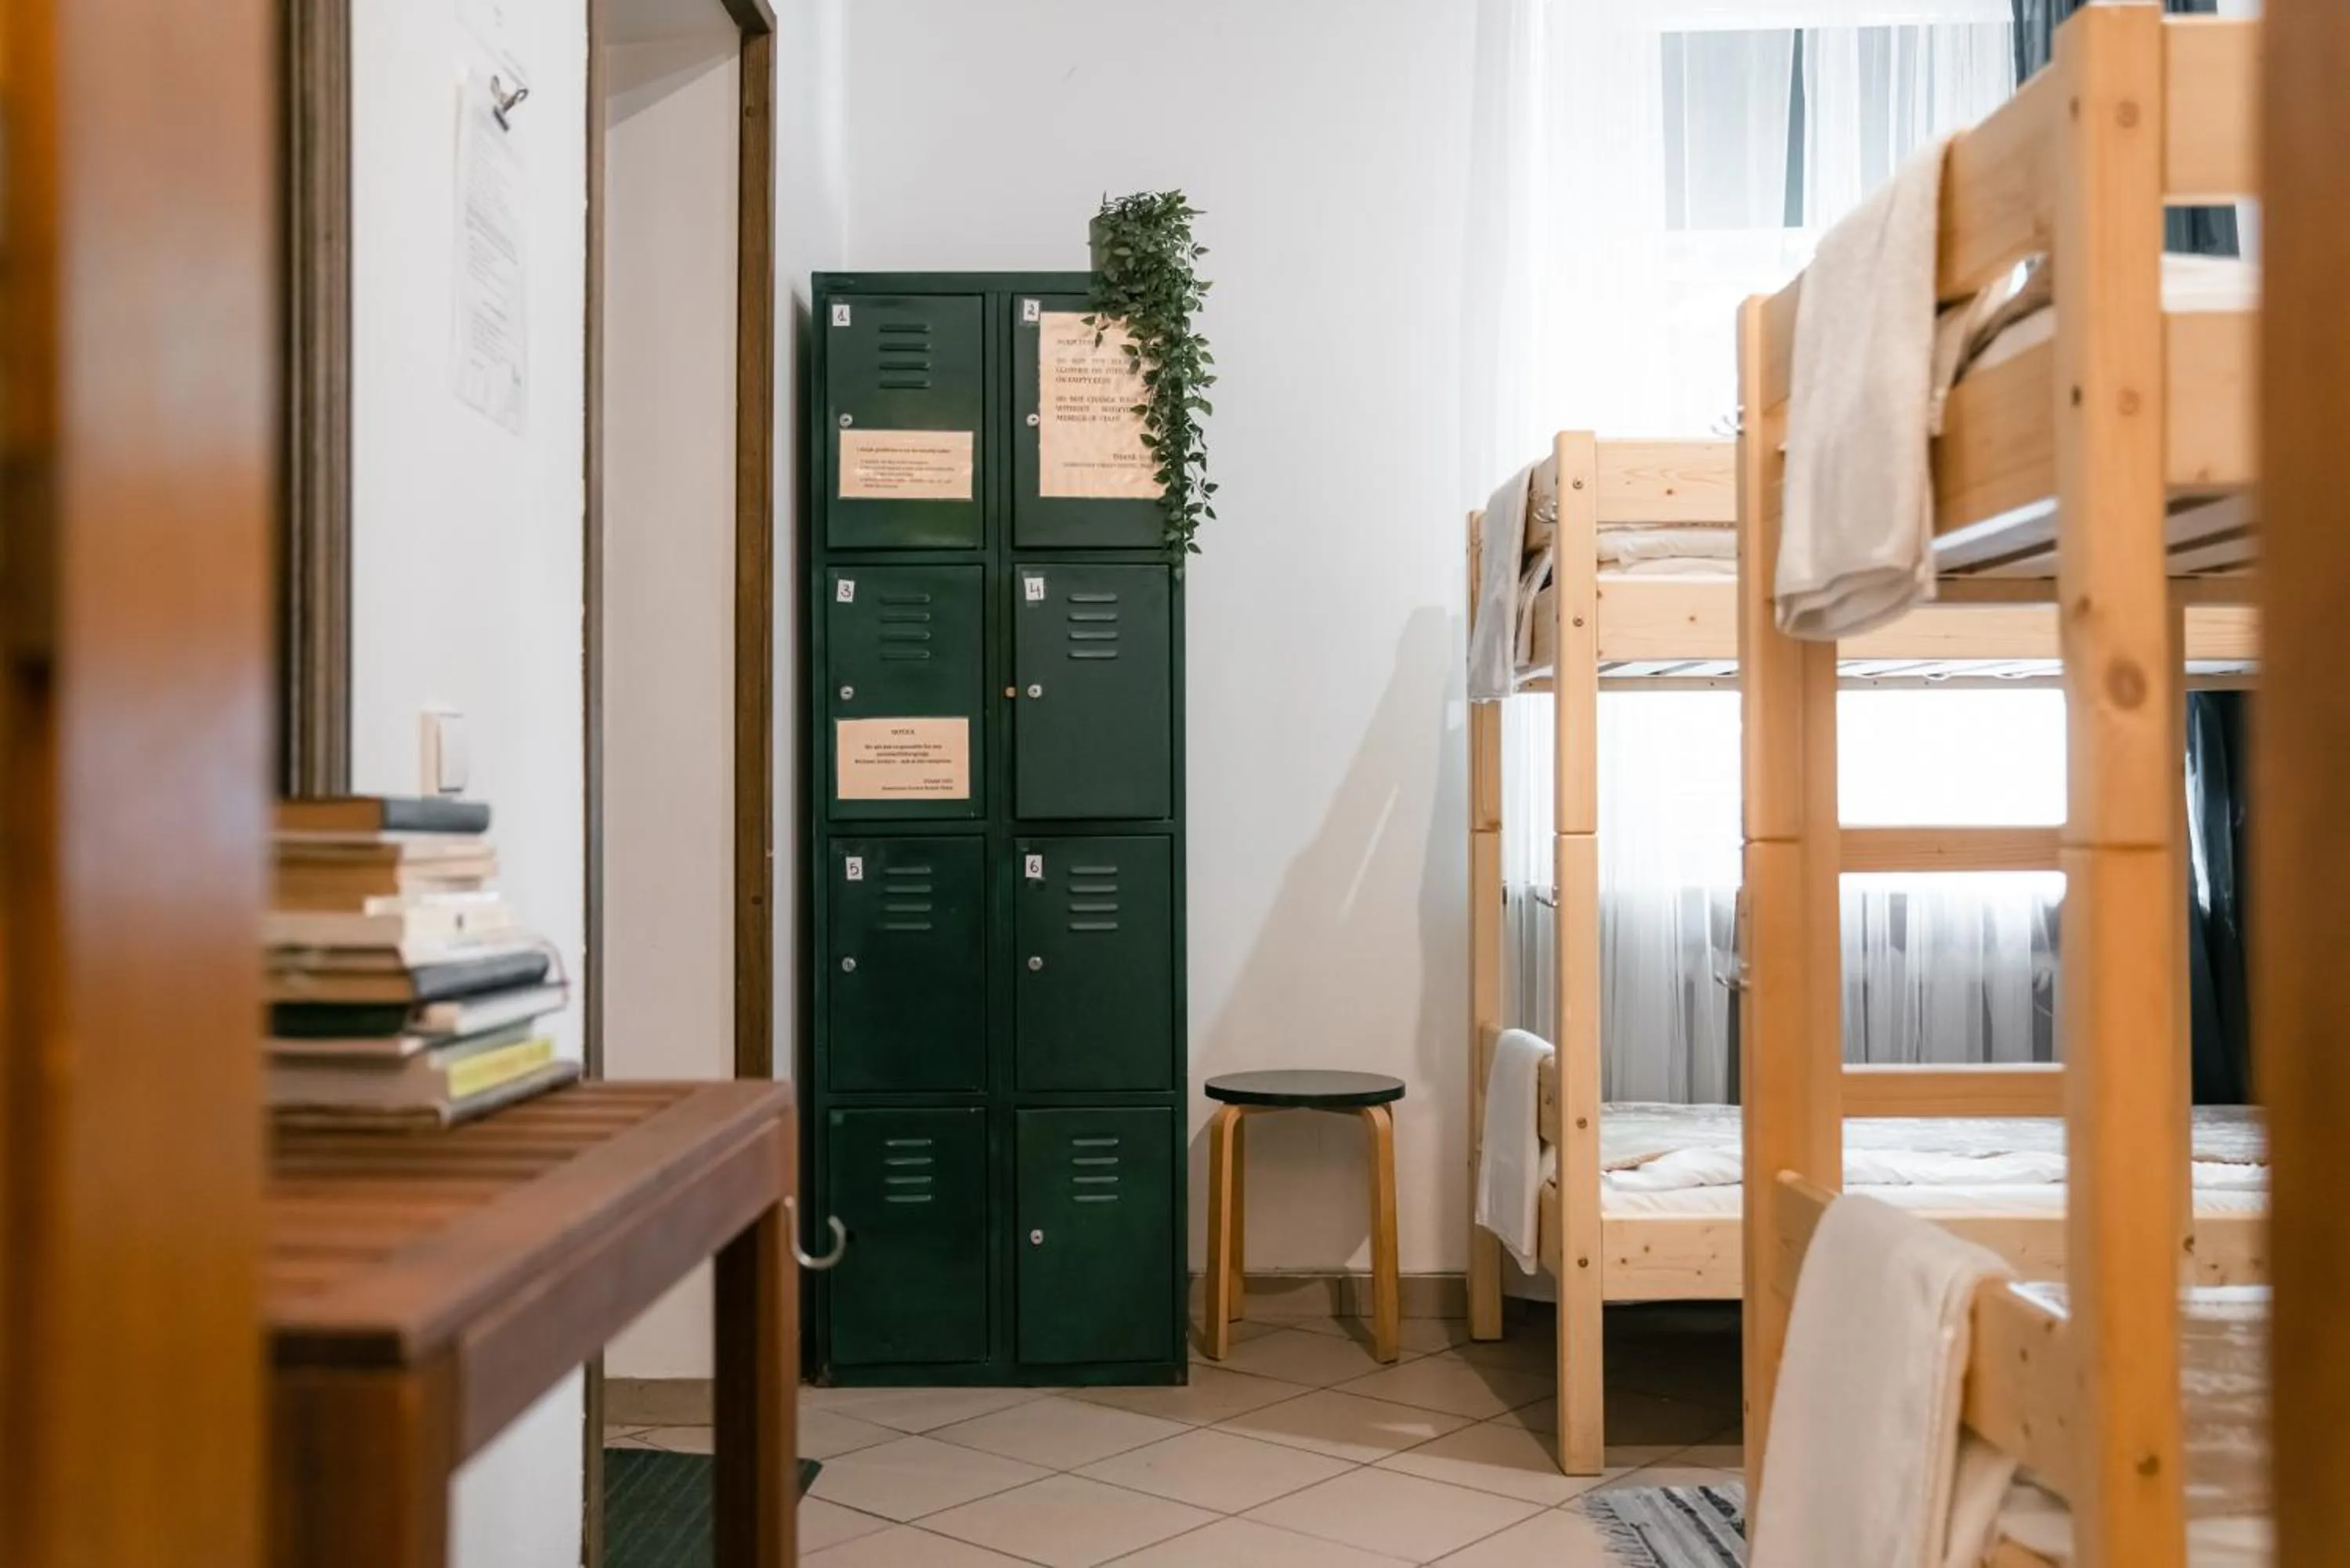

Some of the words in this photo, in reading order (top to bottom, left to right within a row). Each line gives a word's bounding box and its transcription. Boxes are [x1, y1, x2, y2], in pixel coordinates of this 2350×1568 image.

[1027, 303, 1036, 316] 2
[839, 583, 851, 598] 3
[1028, 582, 1041, 598] 4
[848, 862, 860, 876] 5
[1029, 858, 1039, 873] 6
